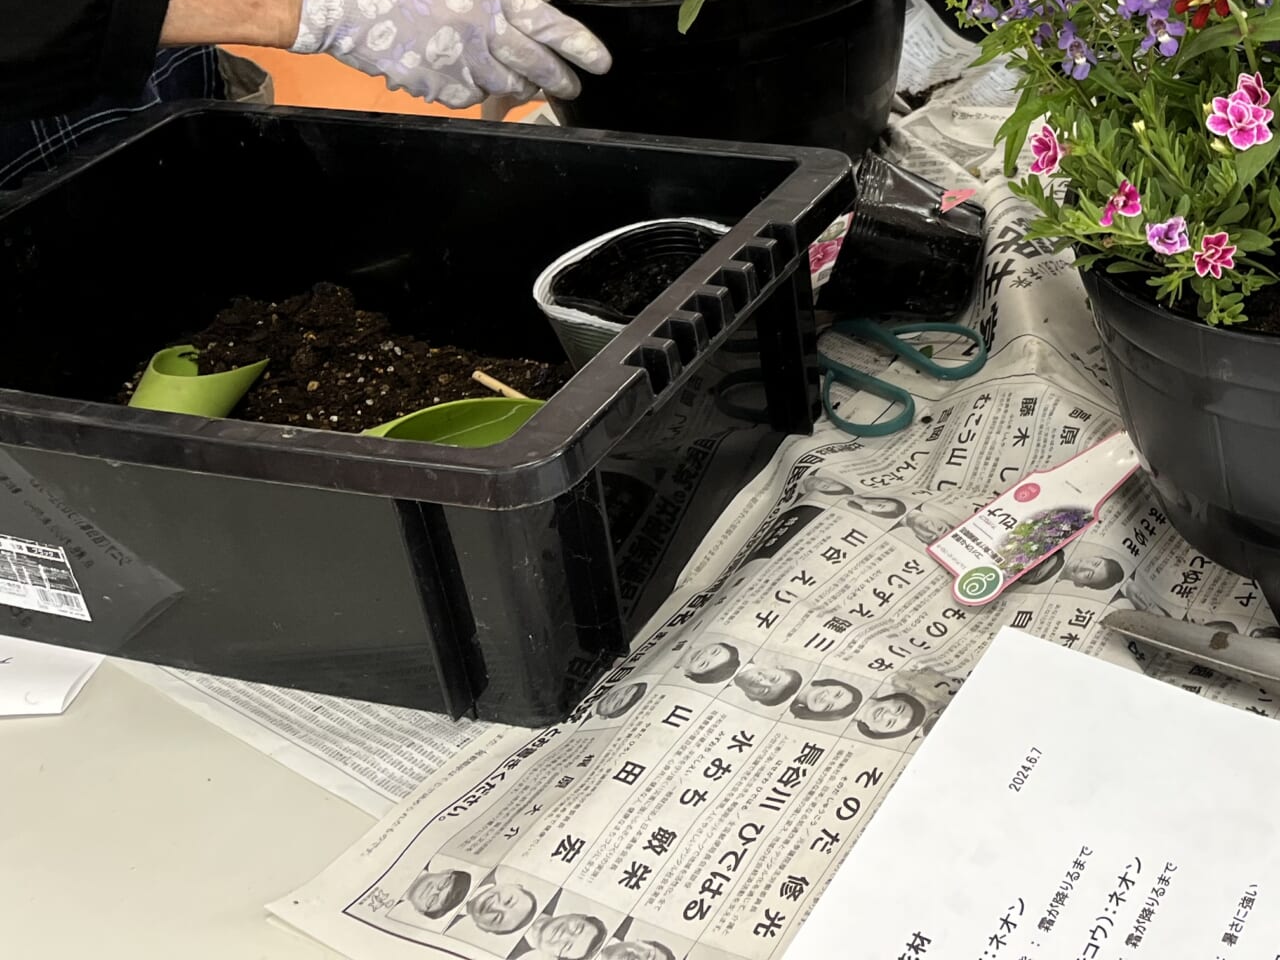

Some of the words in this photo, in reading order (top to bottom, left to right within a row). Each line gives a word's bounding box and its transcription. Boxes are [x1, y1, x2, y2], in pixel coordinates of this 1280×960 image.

[945, 390, 992, 472] むこう山
[1008, 395, 1039, 450] 藤木
[817, 526, 870, 569] 山谷
[985, 503, 1016, 530] セレナ
[1120, 506, 1168, 557] まさゆき
[750, 566, 818, 631] えり子
[865, 602, 967, 674] ものうりお
[675, 726, 757, 814] 水おち
[757, 739, 825, 817] 長谷川
[1006, 745, 1045, 795] 2024.6.7
[808, 760, 884, 859] そのだ
[615, 823, 678, 895] 敏栄
[677, 815, 765, 929] ひではる
[1036, 842, 1095, 934] 霜が降りるまで
[750, 869, 811, 944] 修光
[979, 893, 1030, 960] :ネオン
[1125, 861, 1178, 949] 霜が降りるまで
[1220, 880, 1264, 948] 暑さに強い
